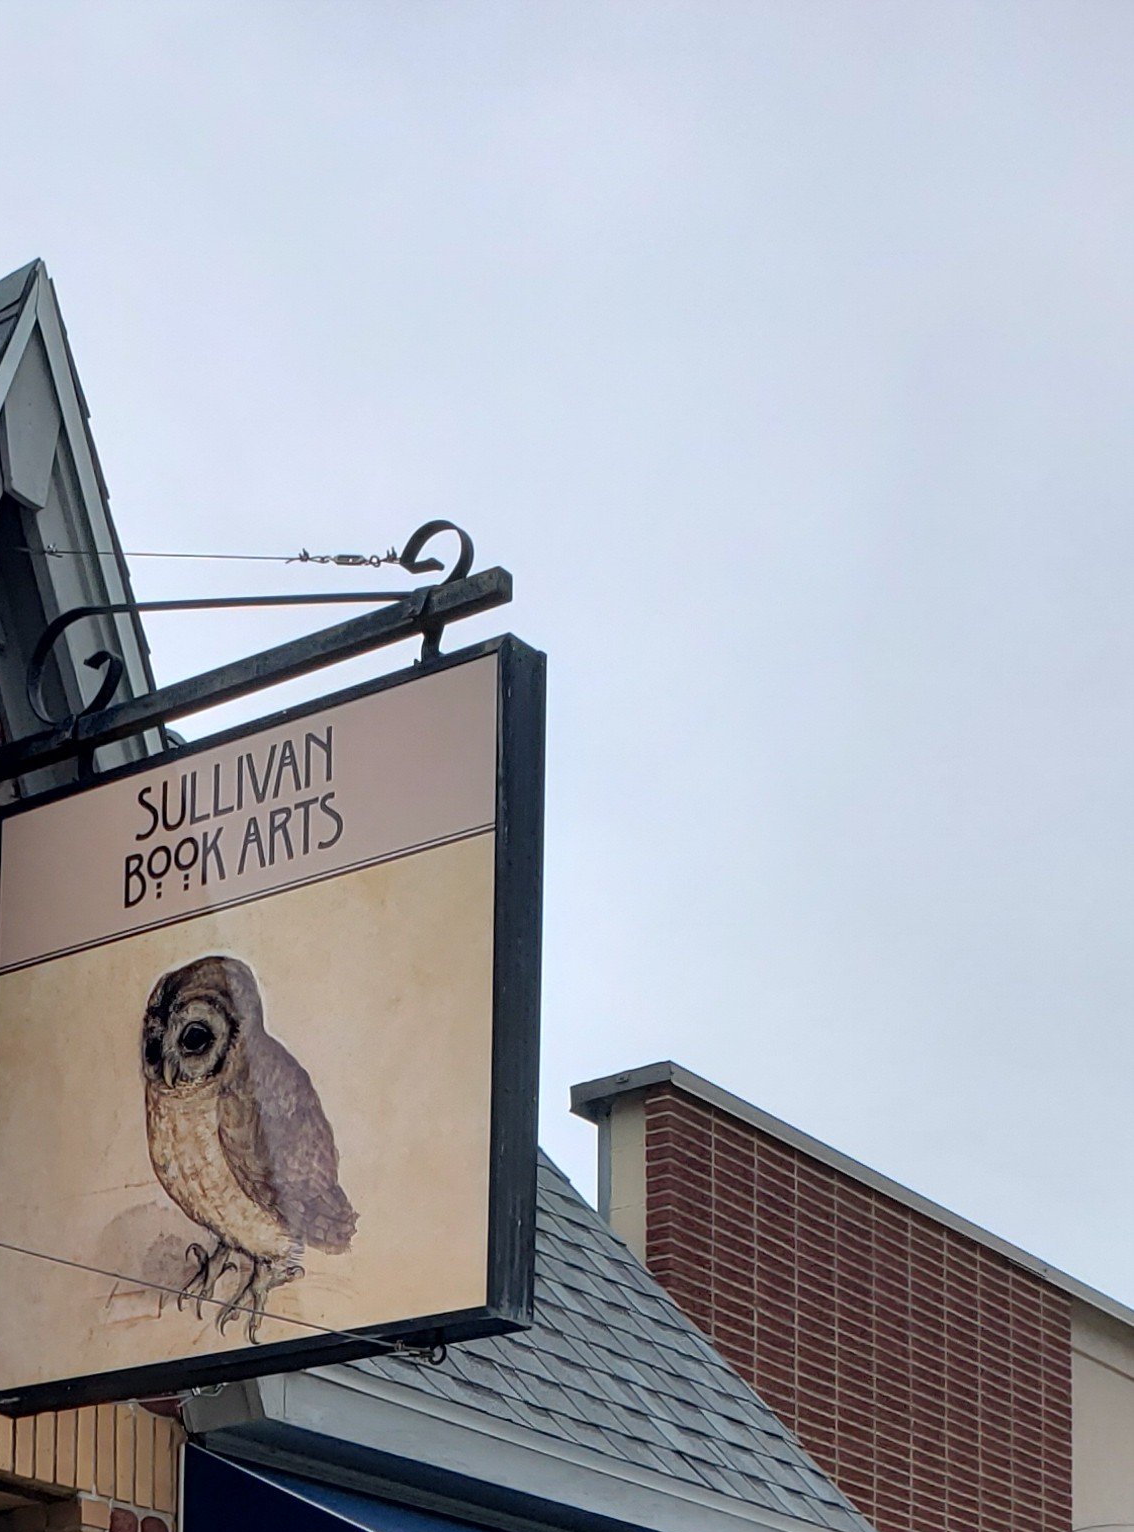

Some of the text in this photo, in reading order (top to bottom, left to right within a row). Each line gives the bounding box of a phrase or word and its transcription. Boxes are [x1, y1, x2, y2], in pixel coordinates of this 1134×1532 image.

[135, 726, 333, 841] SULLIVAN
[124, 791, 344, 909] BOOK ARTS
